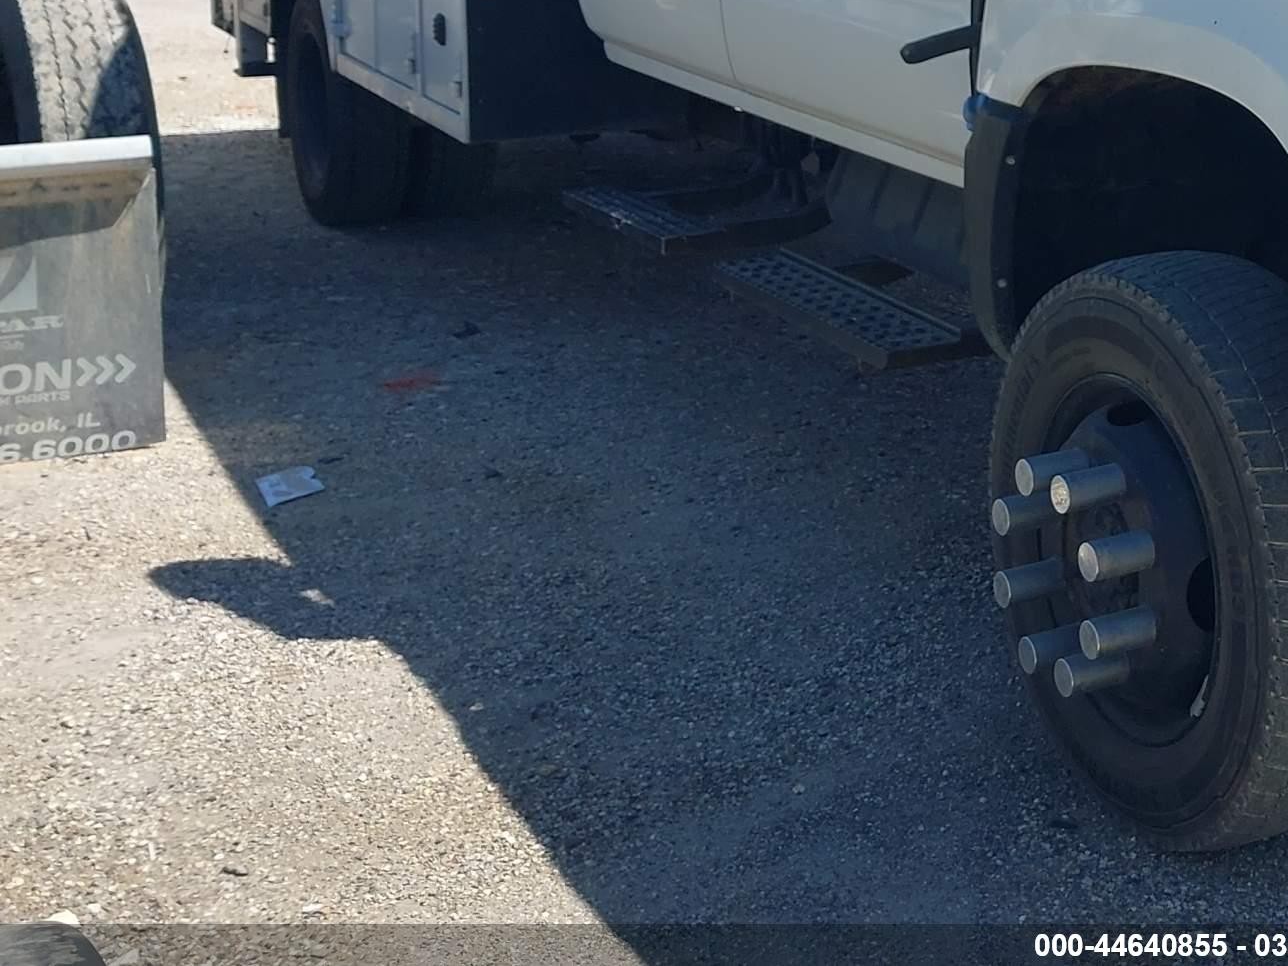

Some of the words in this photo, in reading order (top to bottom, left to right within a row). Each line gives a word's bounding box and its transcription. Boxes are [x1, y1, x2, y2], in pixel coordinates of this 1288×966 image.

[14, 390, 71, 404] PARTS
[0, 417, 66, 436] rook,
[77, 412, 101, 429] IL
